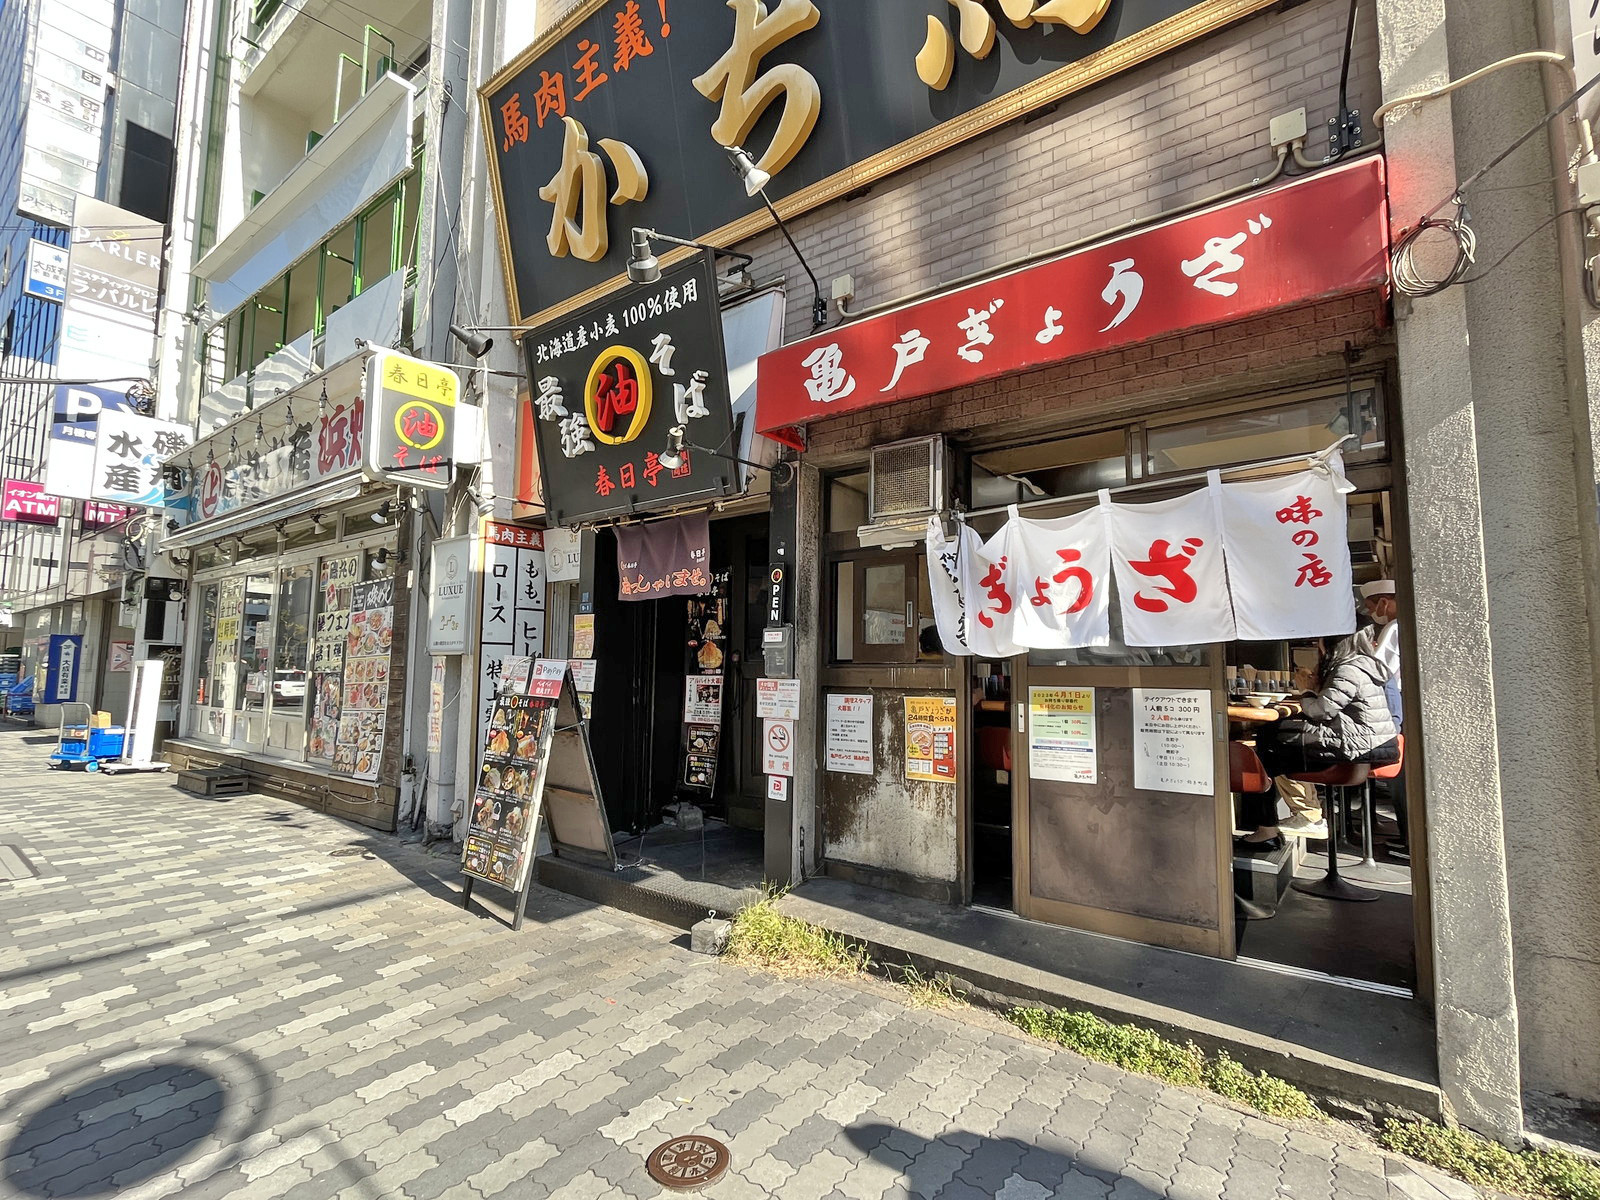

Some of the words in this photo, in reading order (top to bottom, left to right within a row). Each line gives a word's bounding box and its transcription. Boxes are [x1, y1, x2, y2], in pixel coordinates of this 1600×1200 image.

[44, 285, 64, 300] 3F
[801, 213, 1273, 404] 亀戸ぎょうざ
[536, 312, 620, 365] 北海道産小麦
[622, 277, 699, 329] 100%使用
[388, 363, 453, 398] 春日亭
[66, 389, 102, 423] P
[402, 408, 440, 439] 油
[103, 430, 143, 494] 水産
[393, 445, 443, 475] そば
[594, 451, 664, 497] 春日亭
[5, 498, 56, 517] ATM
[1275, 495, 1333, 588] 味の店
[438, 584, 464, 597] LUXUE
[489, 563, 508, 624] ロース
[978, 537, 1204, 629] ぎょうざ
[1144, 696, 1198, 704] テイクアウトできます
